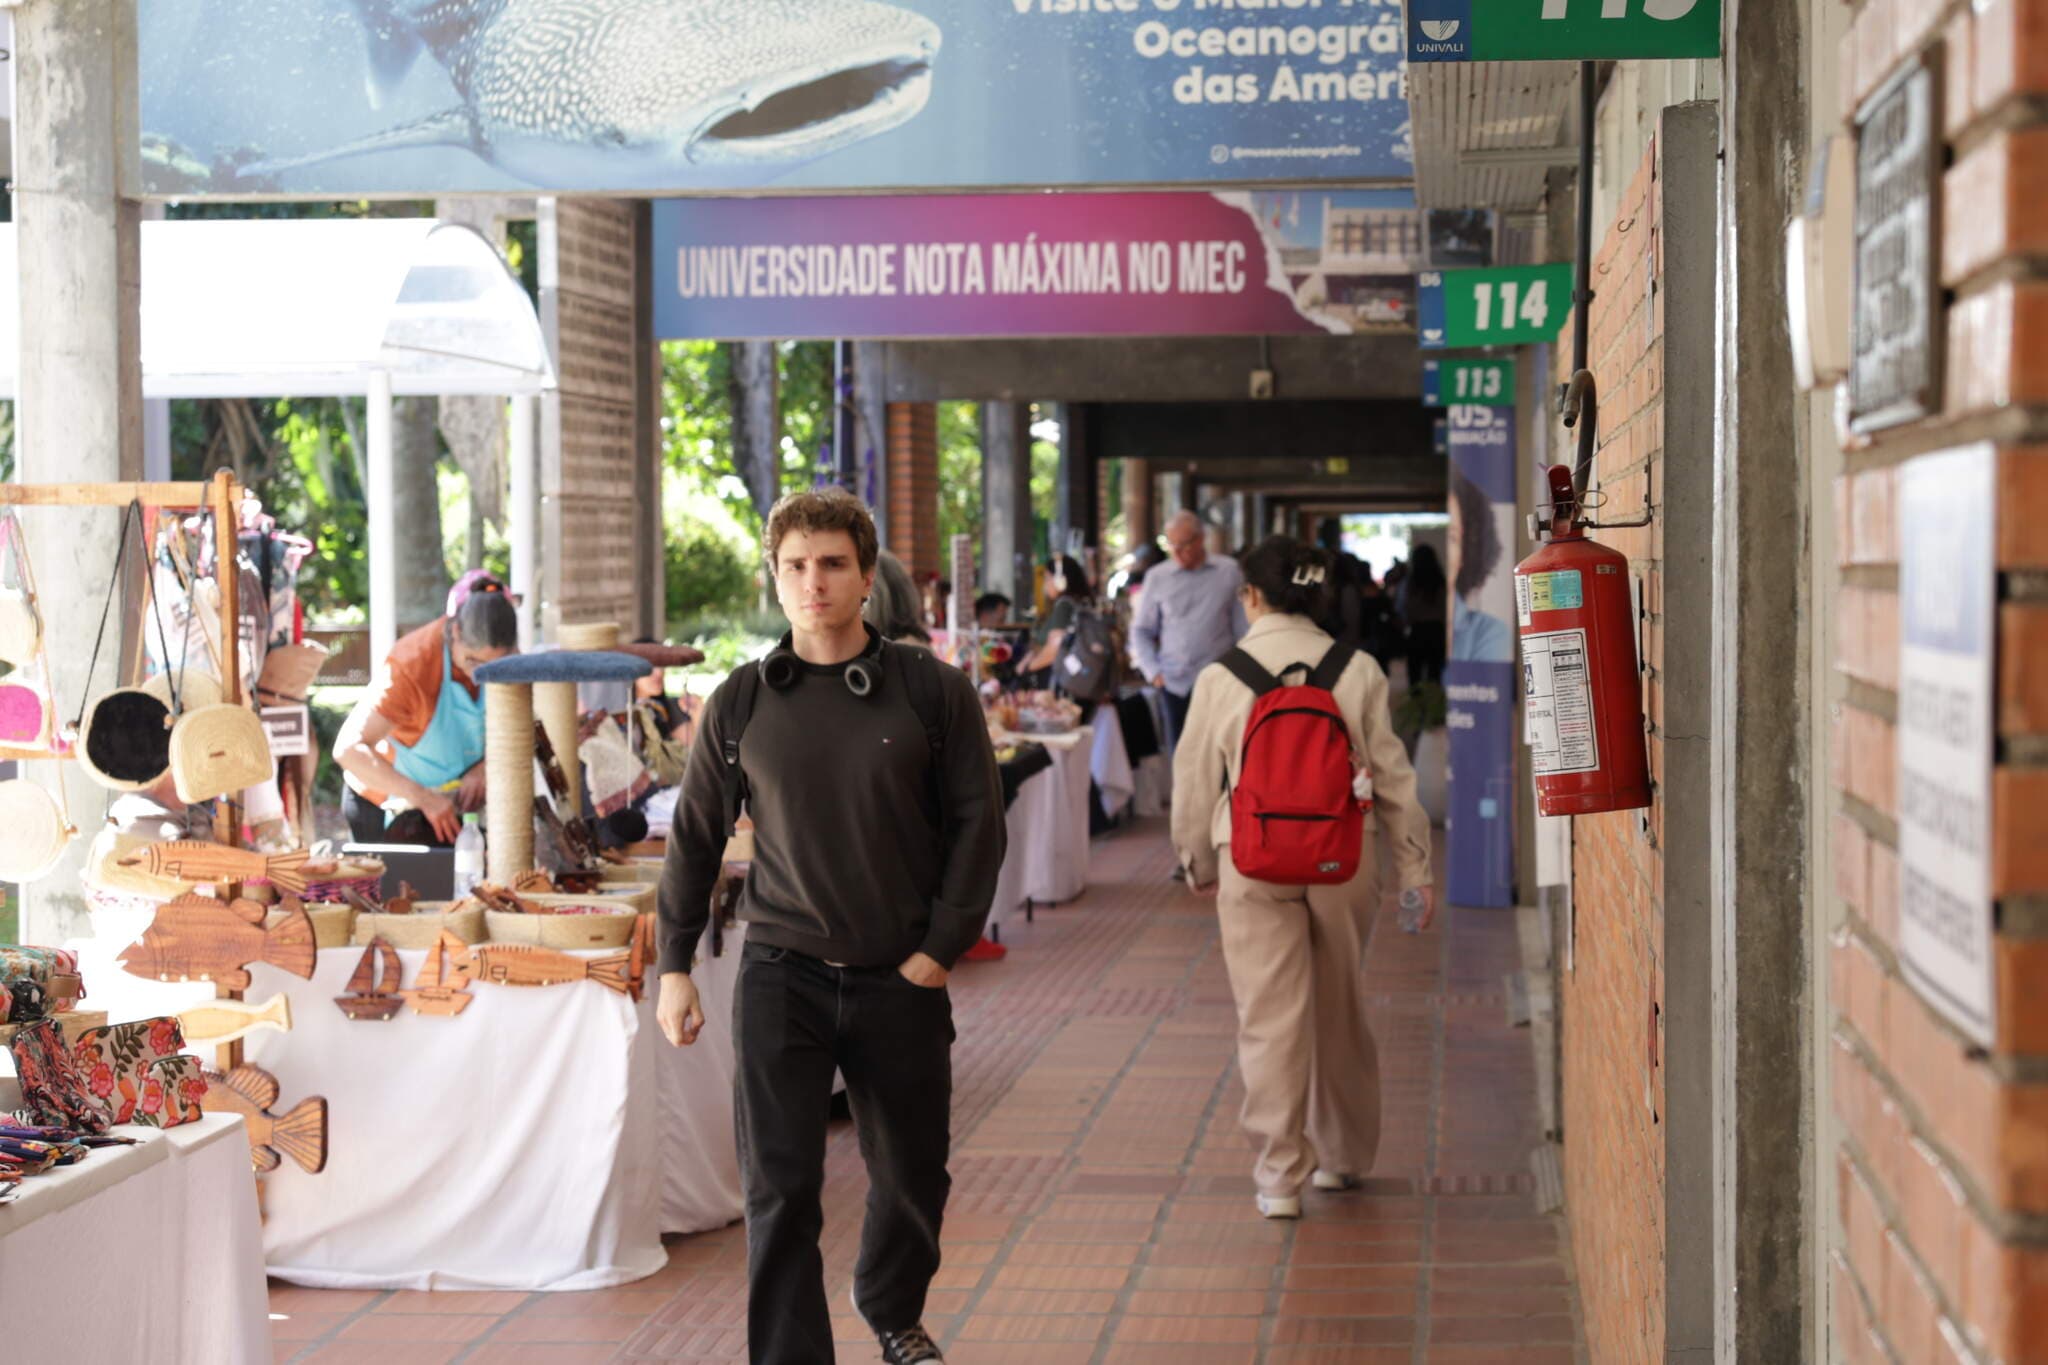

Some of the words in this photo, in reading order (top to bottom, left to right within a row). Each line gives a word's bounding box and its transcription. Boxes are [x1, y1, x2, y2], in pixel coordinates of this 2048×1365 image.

[1416, 43, 1464, 54] UNIVALI
[1173, 66, 1259, 104] das
[678, 245, 897, 298] UNIVERSIDADE
[904, 243, 986, 295] NOTA
[992, 231, 1122, 294] MÁXIMA
[1128, 241, 1171, 293] NO
[1178, 240, 1246, 293] MEC
[1474, 280, 1548, 331] 114
[1456, 367, 1500, 398] 113
